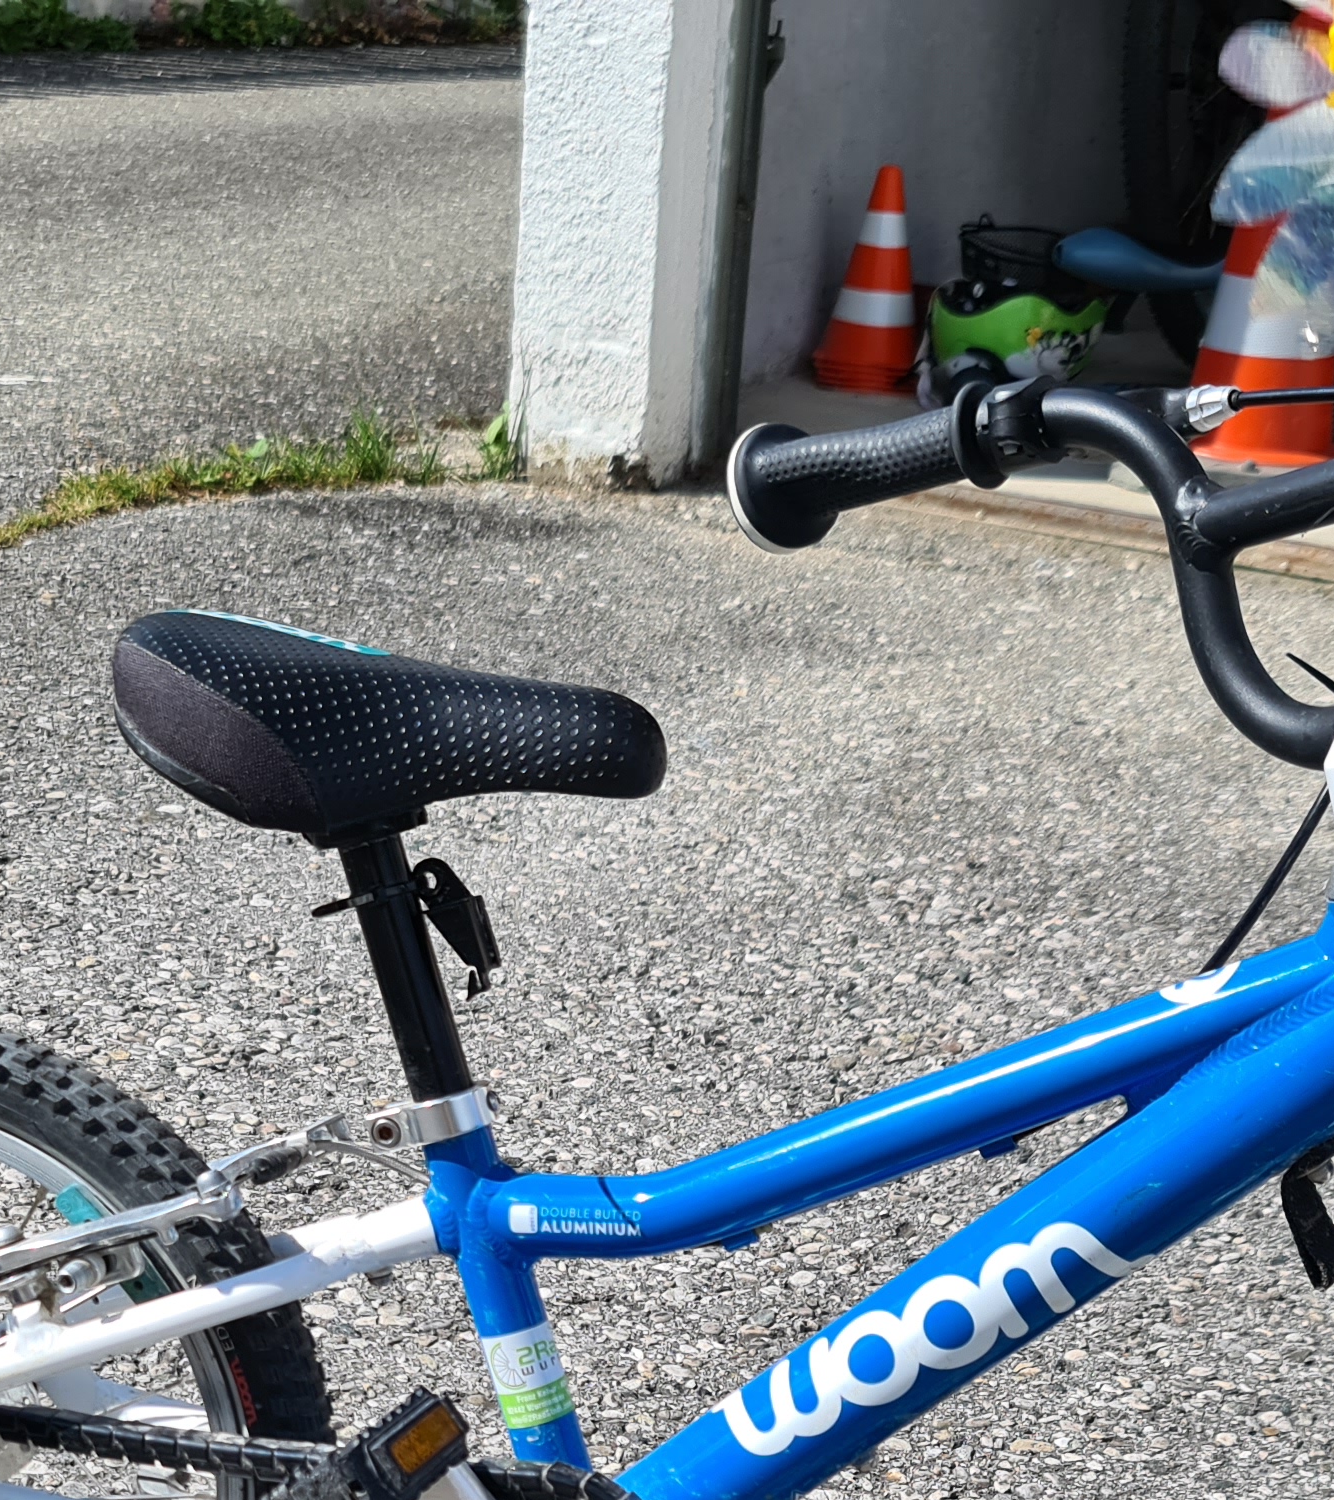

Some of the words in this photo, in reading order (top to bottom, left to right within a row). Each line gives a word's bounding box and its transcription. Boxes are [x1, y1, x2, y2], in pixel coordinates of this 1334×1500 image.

[540, 1207, 590, 1219] DOUBLE
[540, 1219, 642, 1237] ALUMINIUM
[713, 1222, 1151, 1456] woom
